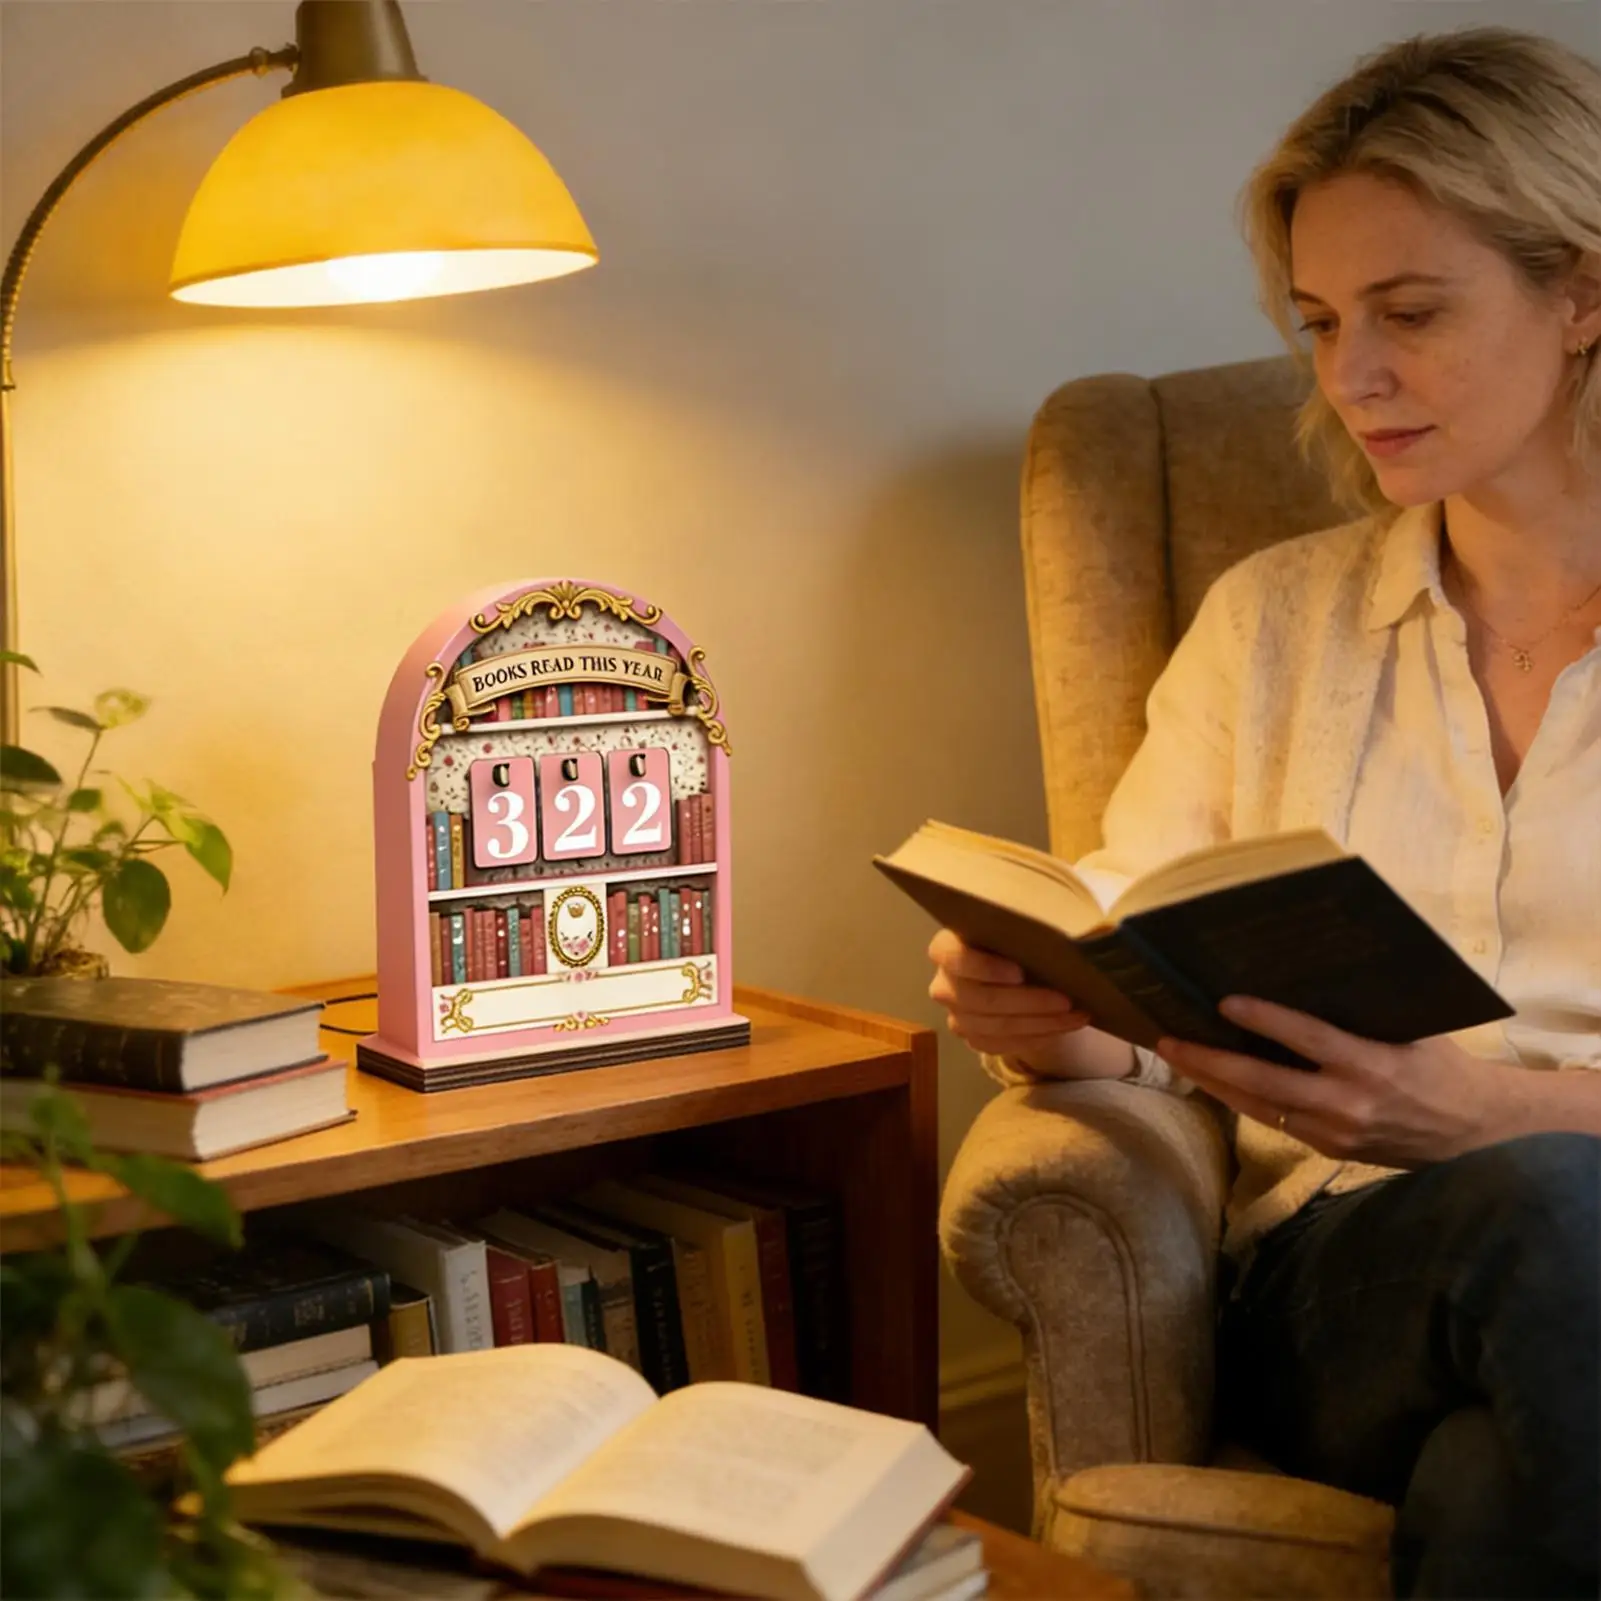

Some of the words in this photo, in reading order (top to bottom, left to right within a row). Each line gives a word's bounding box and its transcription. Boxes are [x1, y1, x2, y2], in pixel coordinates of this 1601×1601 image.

[472, 664, 528, 693] BOOKS
[531, 656, 574, 676] READ
[579, 656, 617, 672] THIS
[623, 660, 664, 682] YEAR
